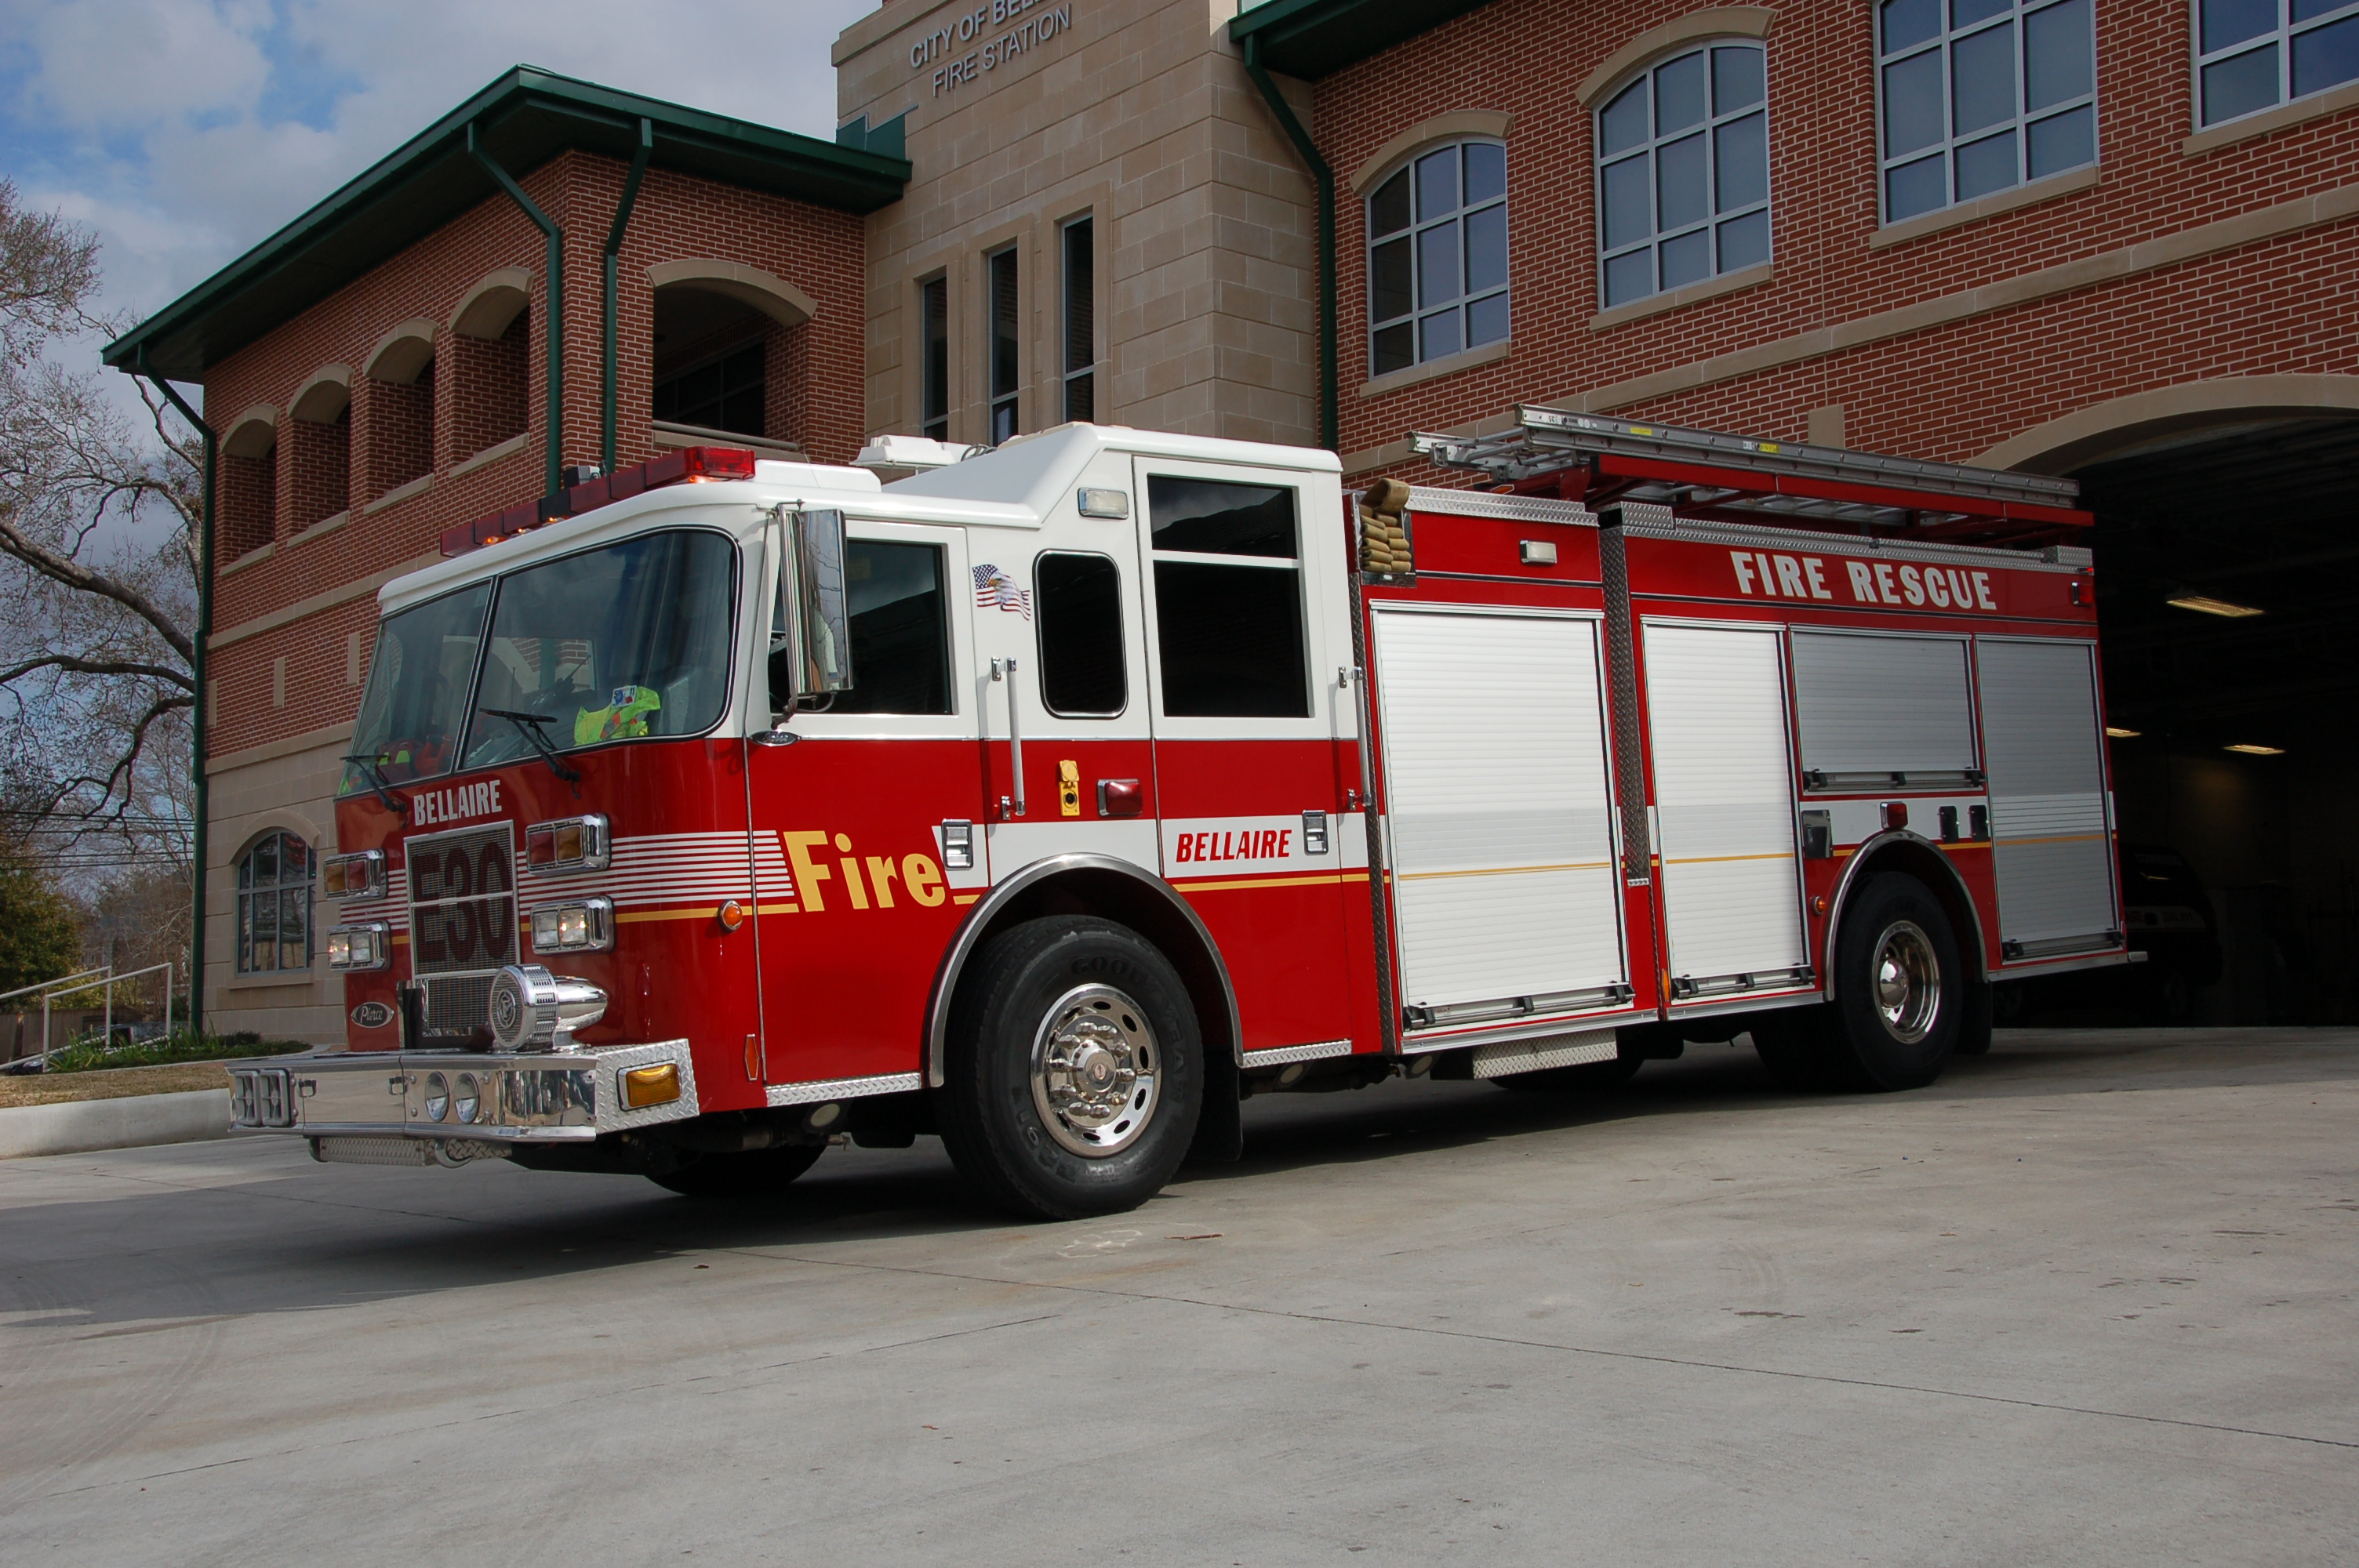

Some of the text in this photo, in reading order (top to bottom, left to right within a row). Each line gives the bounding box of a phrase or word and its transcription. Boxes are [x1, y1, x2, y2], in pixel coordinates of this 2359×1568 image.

[910, 24, 955, 68] CITY
[958, 5, 988, 42] OF
[932, 2, 1072, 98] FIRE STATION
[1729, 551, 1997, 611] FIRE RESCUE
[413, 780, 503, 826] BELLAIRE
[783, 829, 946, 913] Fire
[1176, 829, 1292, 863] BELLAIRE
[410, 841, 514, 962] E30
[360, 1005, 383, 1024] Pierce
[1070, 956, 1187, 1102] GOODYEAR
